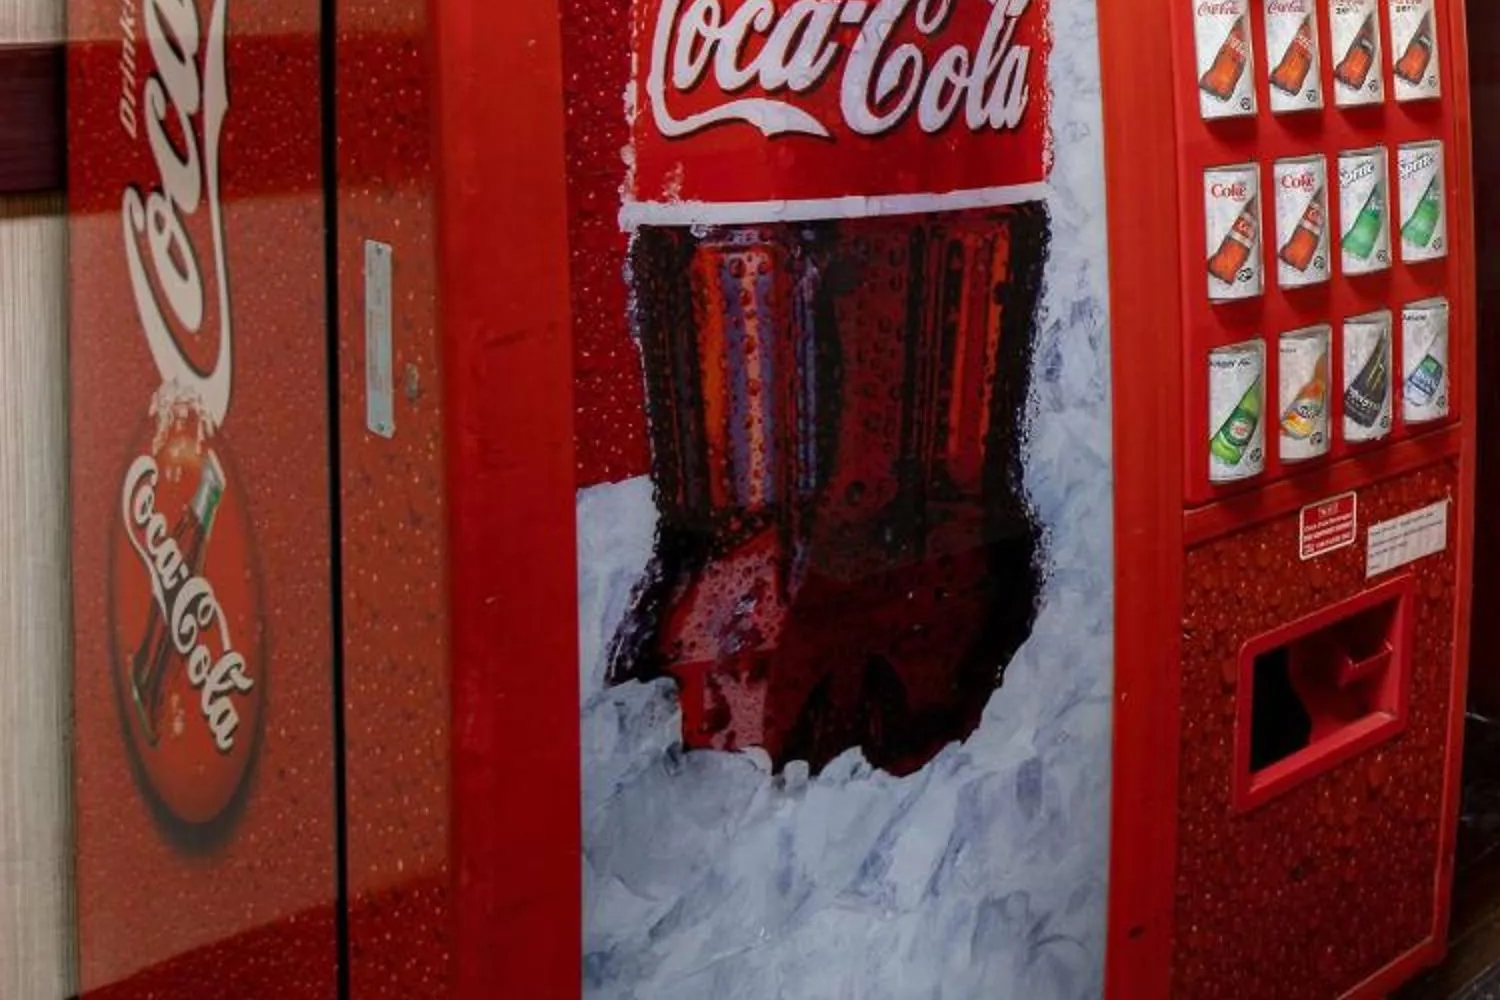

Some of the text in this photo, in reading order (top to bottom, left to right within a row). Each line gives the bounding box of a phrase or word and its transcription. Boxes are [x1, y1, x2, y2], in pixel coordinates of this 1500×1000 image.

[1281, 172, 1315, 189] Coke
[1211, 182, 1247, 199] Coke
[122, 454, 253, 754] Coca-Cola
